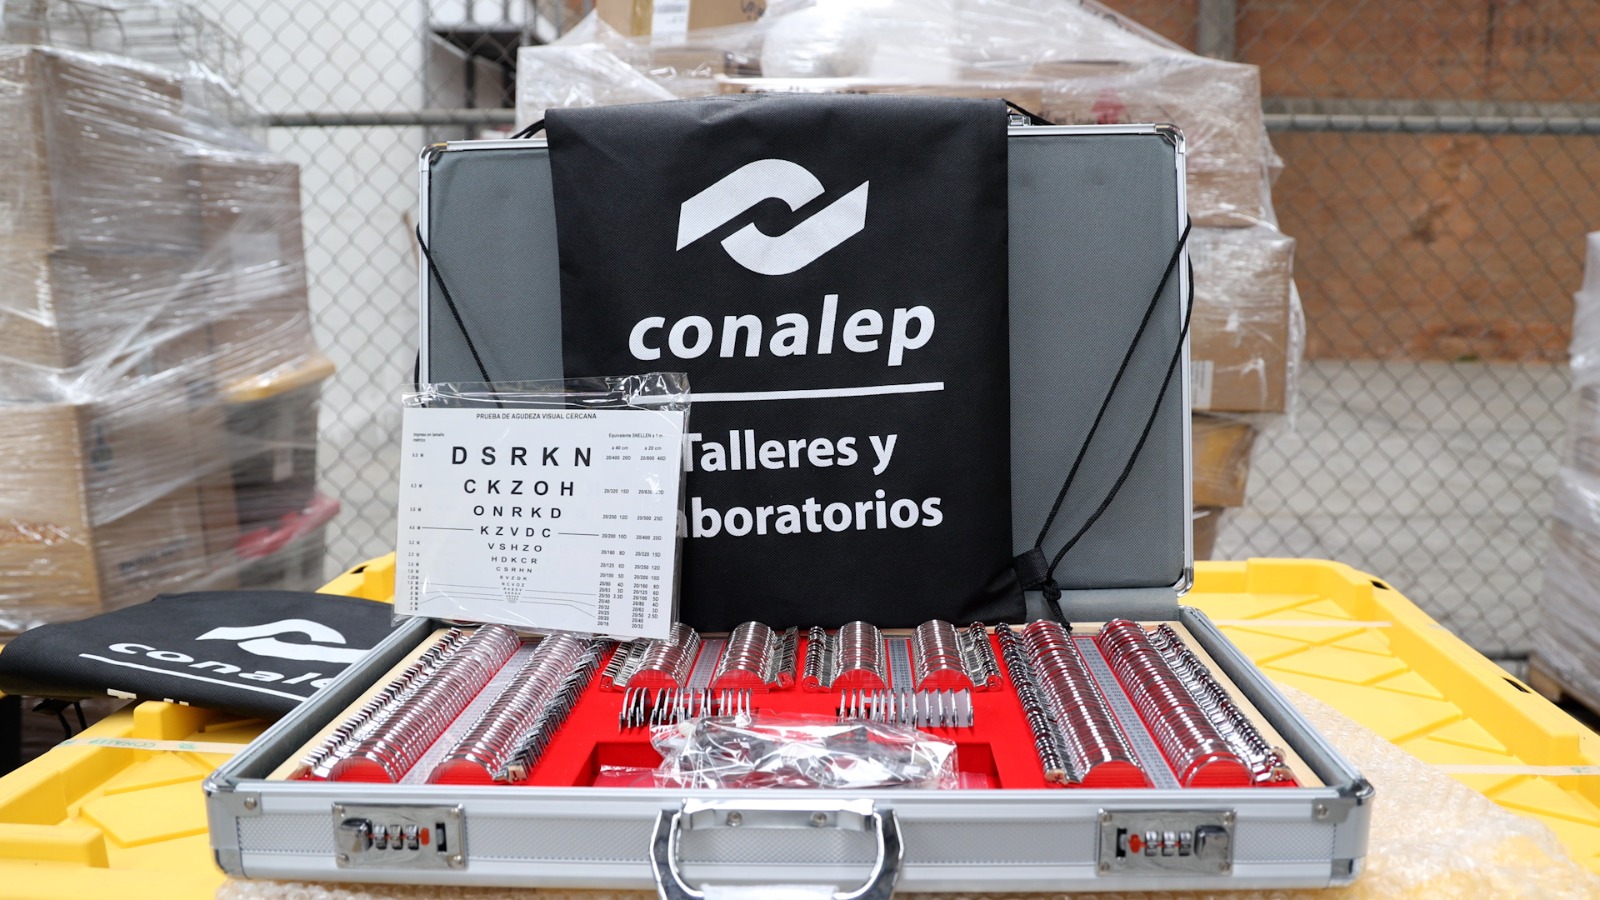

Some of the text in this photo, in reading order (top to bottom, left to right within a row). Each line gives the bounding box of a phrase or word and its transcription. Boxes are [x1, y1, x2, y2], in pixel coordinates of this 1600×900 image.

[628, 294, 935, 366] conalep
[683, 429, 898, 475] Talleres y
